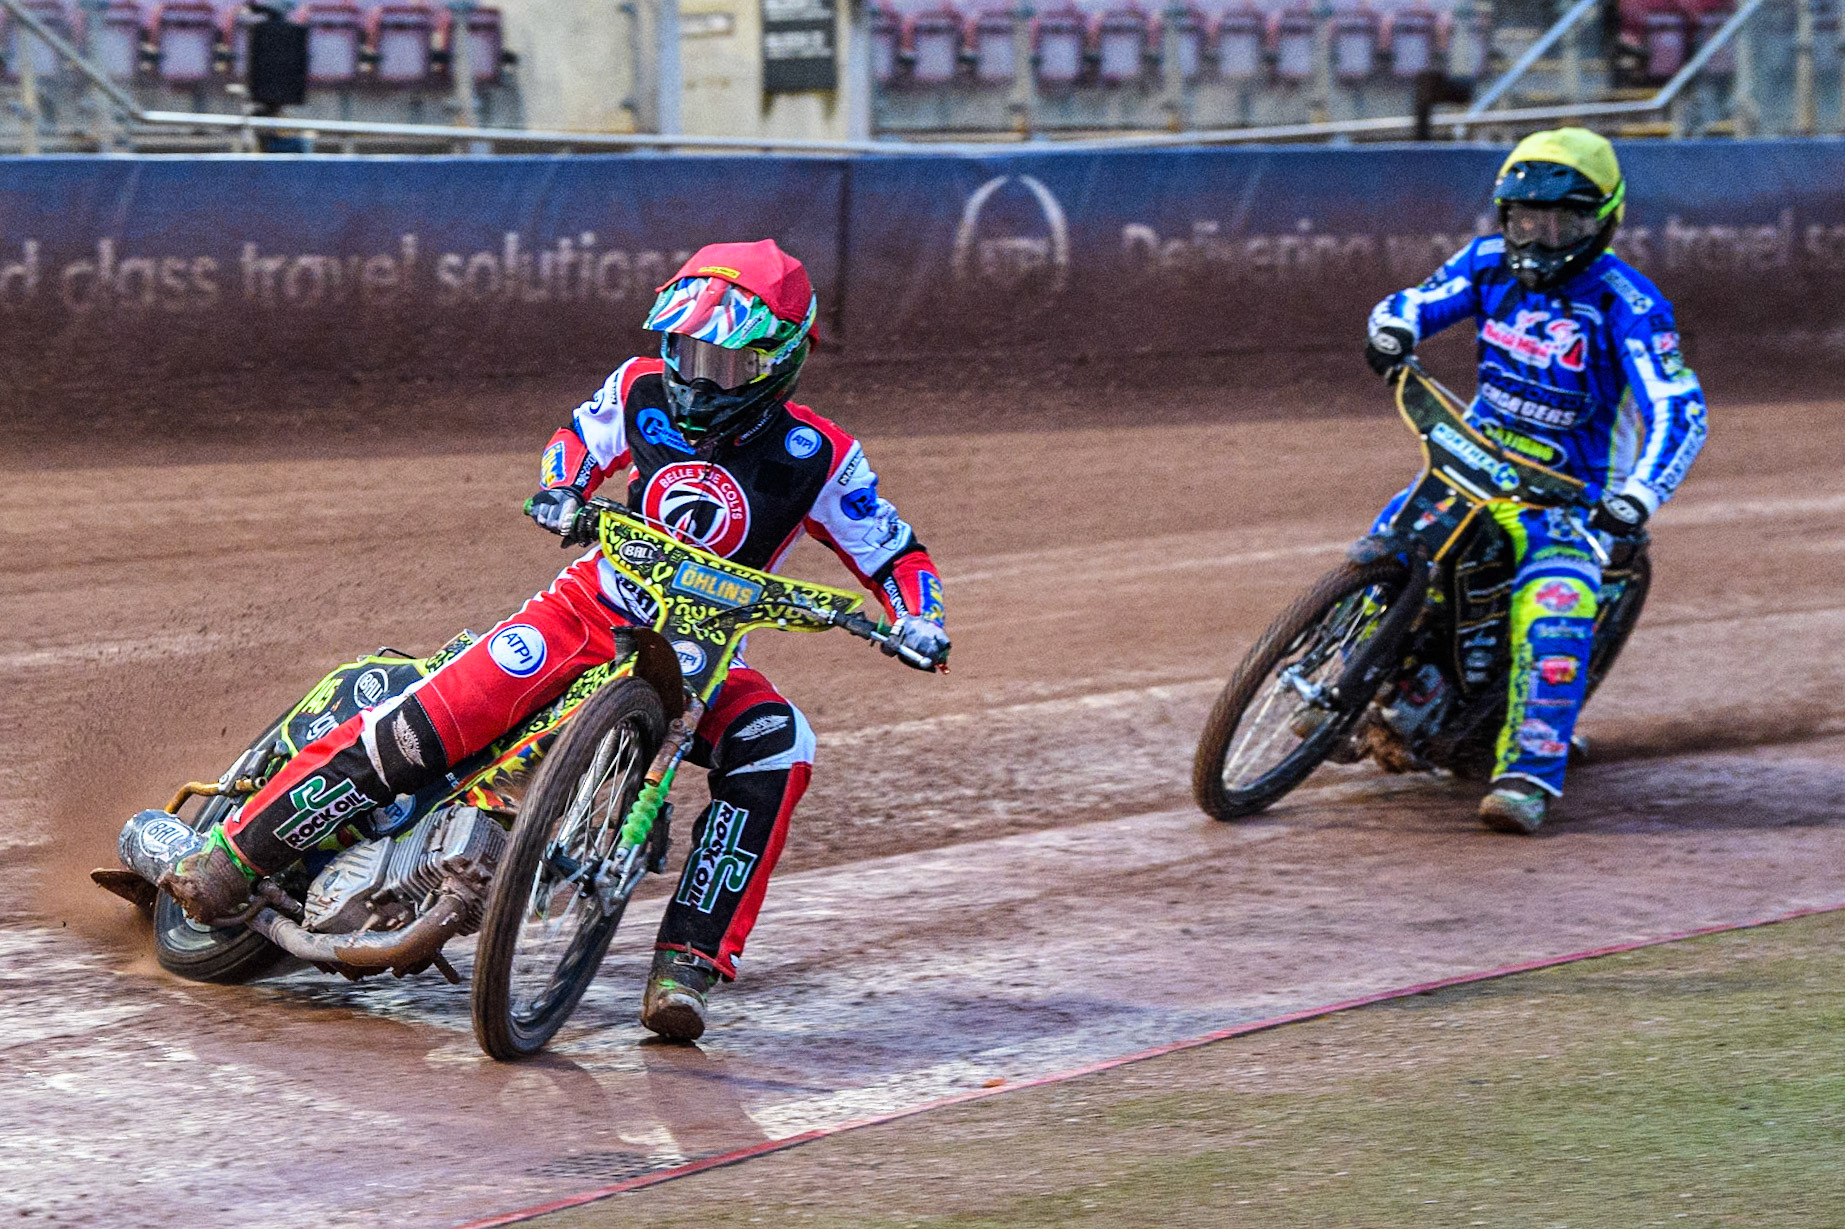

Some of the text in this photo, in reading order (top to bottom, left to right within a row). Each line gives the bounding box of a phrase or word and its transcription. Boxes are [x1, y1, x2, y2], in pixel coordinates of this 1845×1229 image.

[659, 468, 694, 488] BELLE
[721, 483, 744, 520] COLTS
[502, 633, 533, 664] ATPI
[676, 651, 698, 666] TPI
[285, 792, 368, 846] ROCK OIL
[689, 804, 735, 909] ROCK OIL
